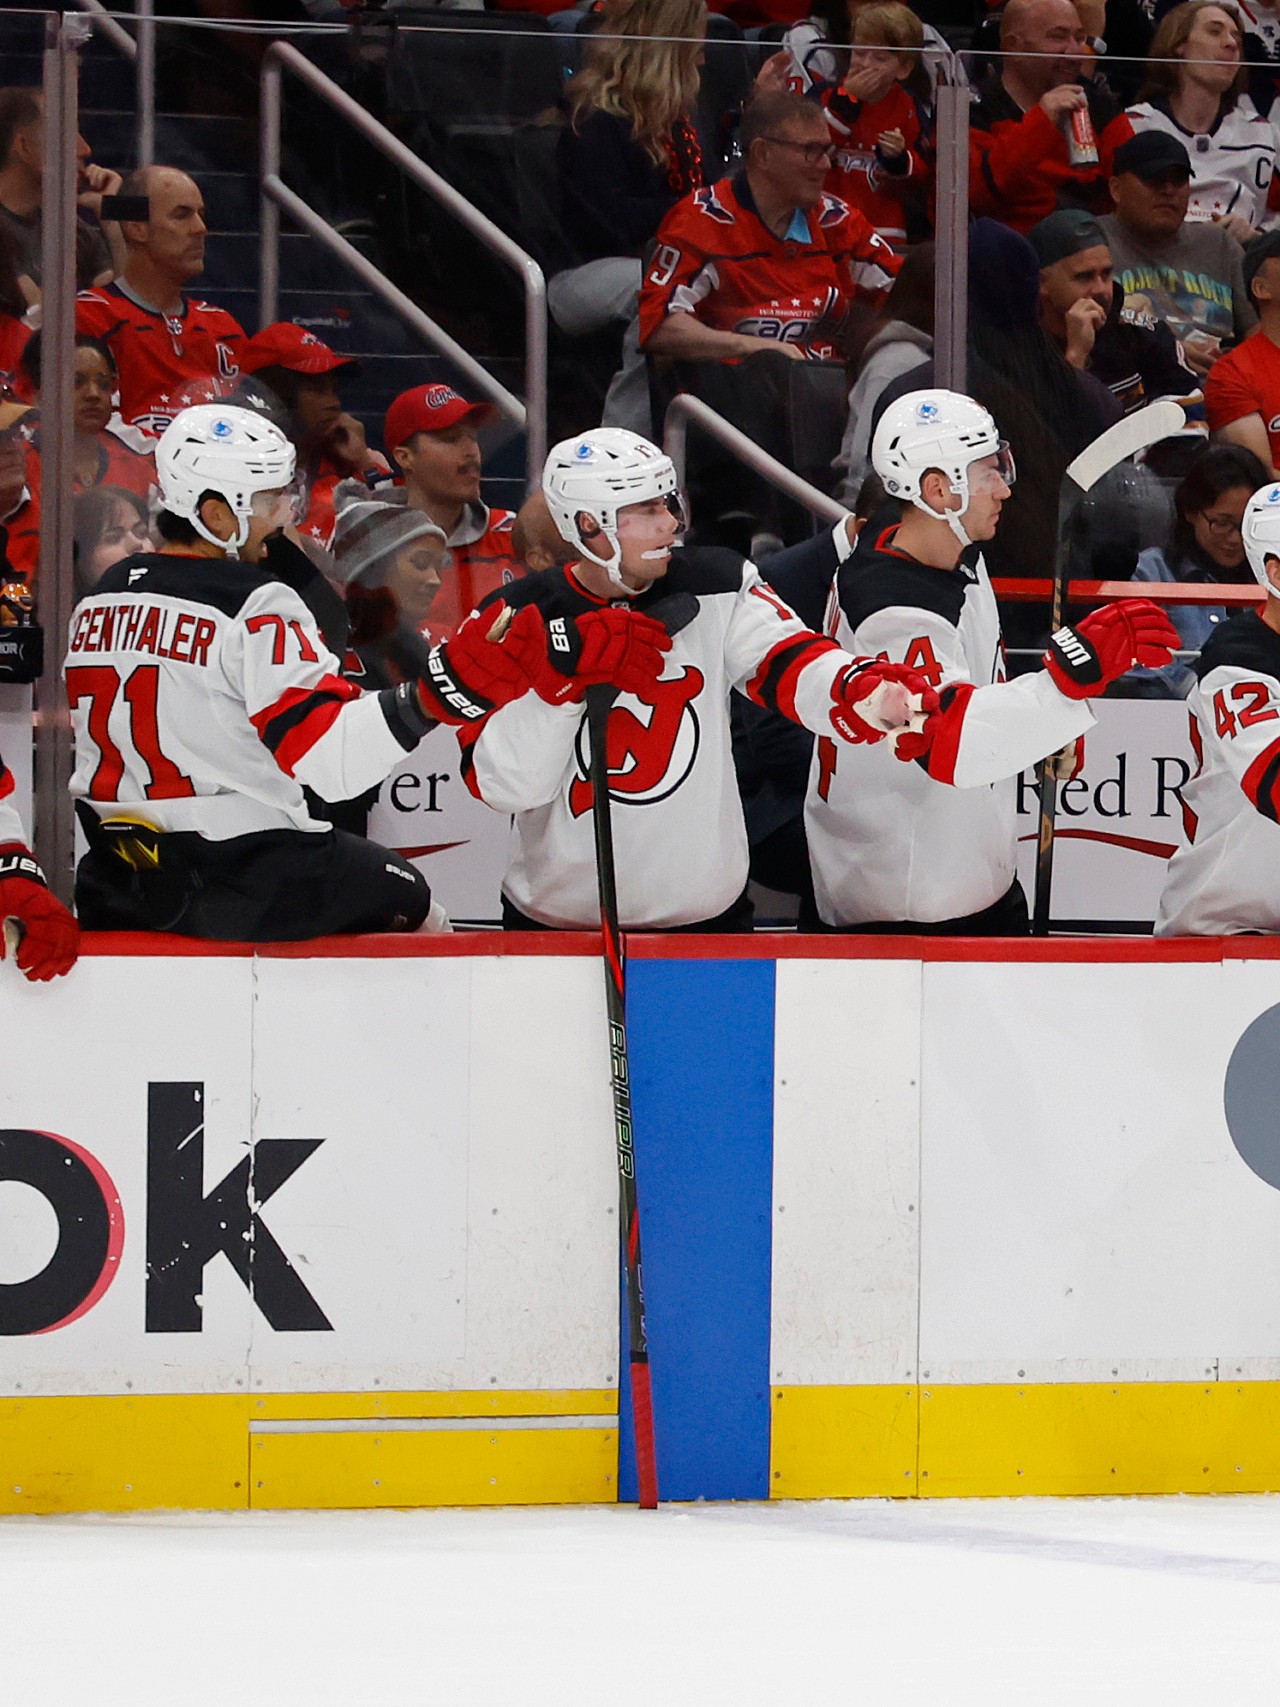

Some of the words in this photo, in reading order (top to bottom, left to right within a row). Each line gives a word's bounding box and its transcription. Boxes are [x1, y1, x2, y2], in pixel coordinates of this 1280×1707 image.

[1255, 157, 1272, 189] C
[650, 244, 681, 286] 9
[215, 343, 239, 378] C
[245, 614, 320, 665] 71
[1213, 681, 1280, 740] 42
[65, 665, 196, 803] 71
[387, 773, 451, 812] er
[1150, 757, 1191, 818] R
